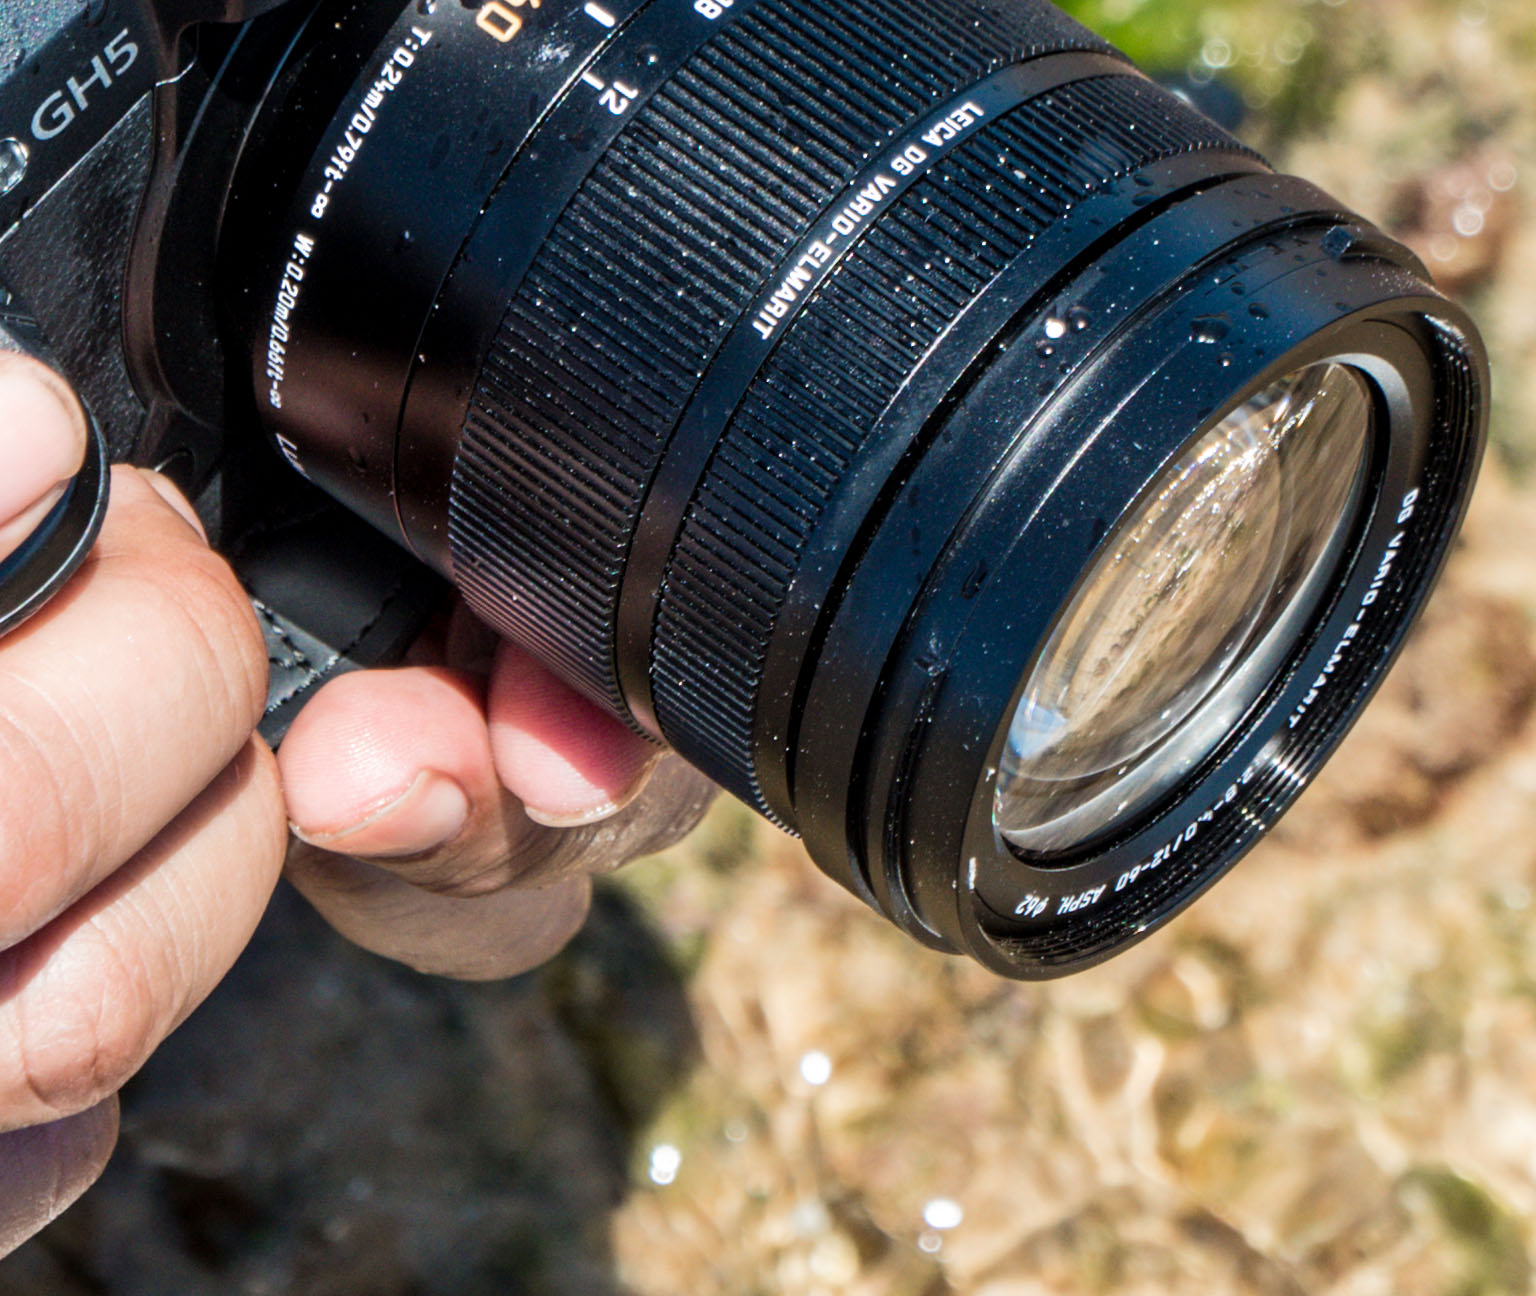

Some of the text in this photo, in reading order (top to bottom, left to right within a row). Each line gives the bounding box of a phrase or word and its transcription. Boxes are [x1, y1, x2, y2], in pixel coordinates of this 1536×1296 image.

[31, 28, 139, 141] GH5
[598, 81, 639, 115] 12
[751, 101, 985, 341] LEICA DG VARIO-ELMARIT
[1396, 487, 1419, 525] DG
[1289, 531, 1405, 729] VARIO-ELMARIT
